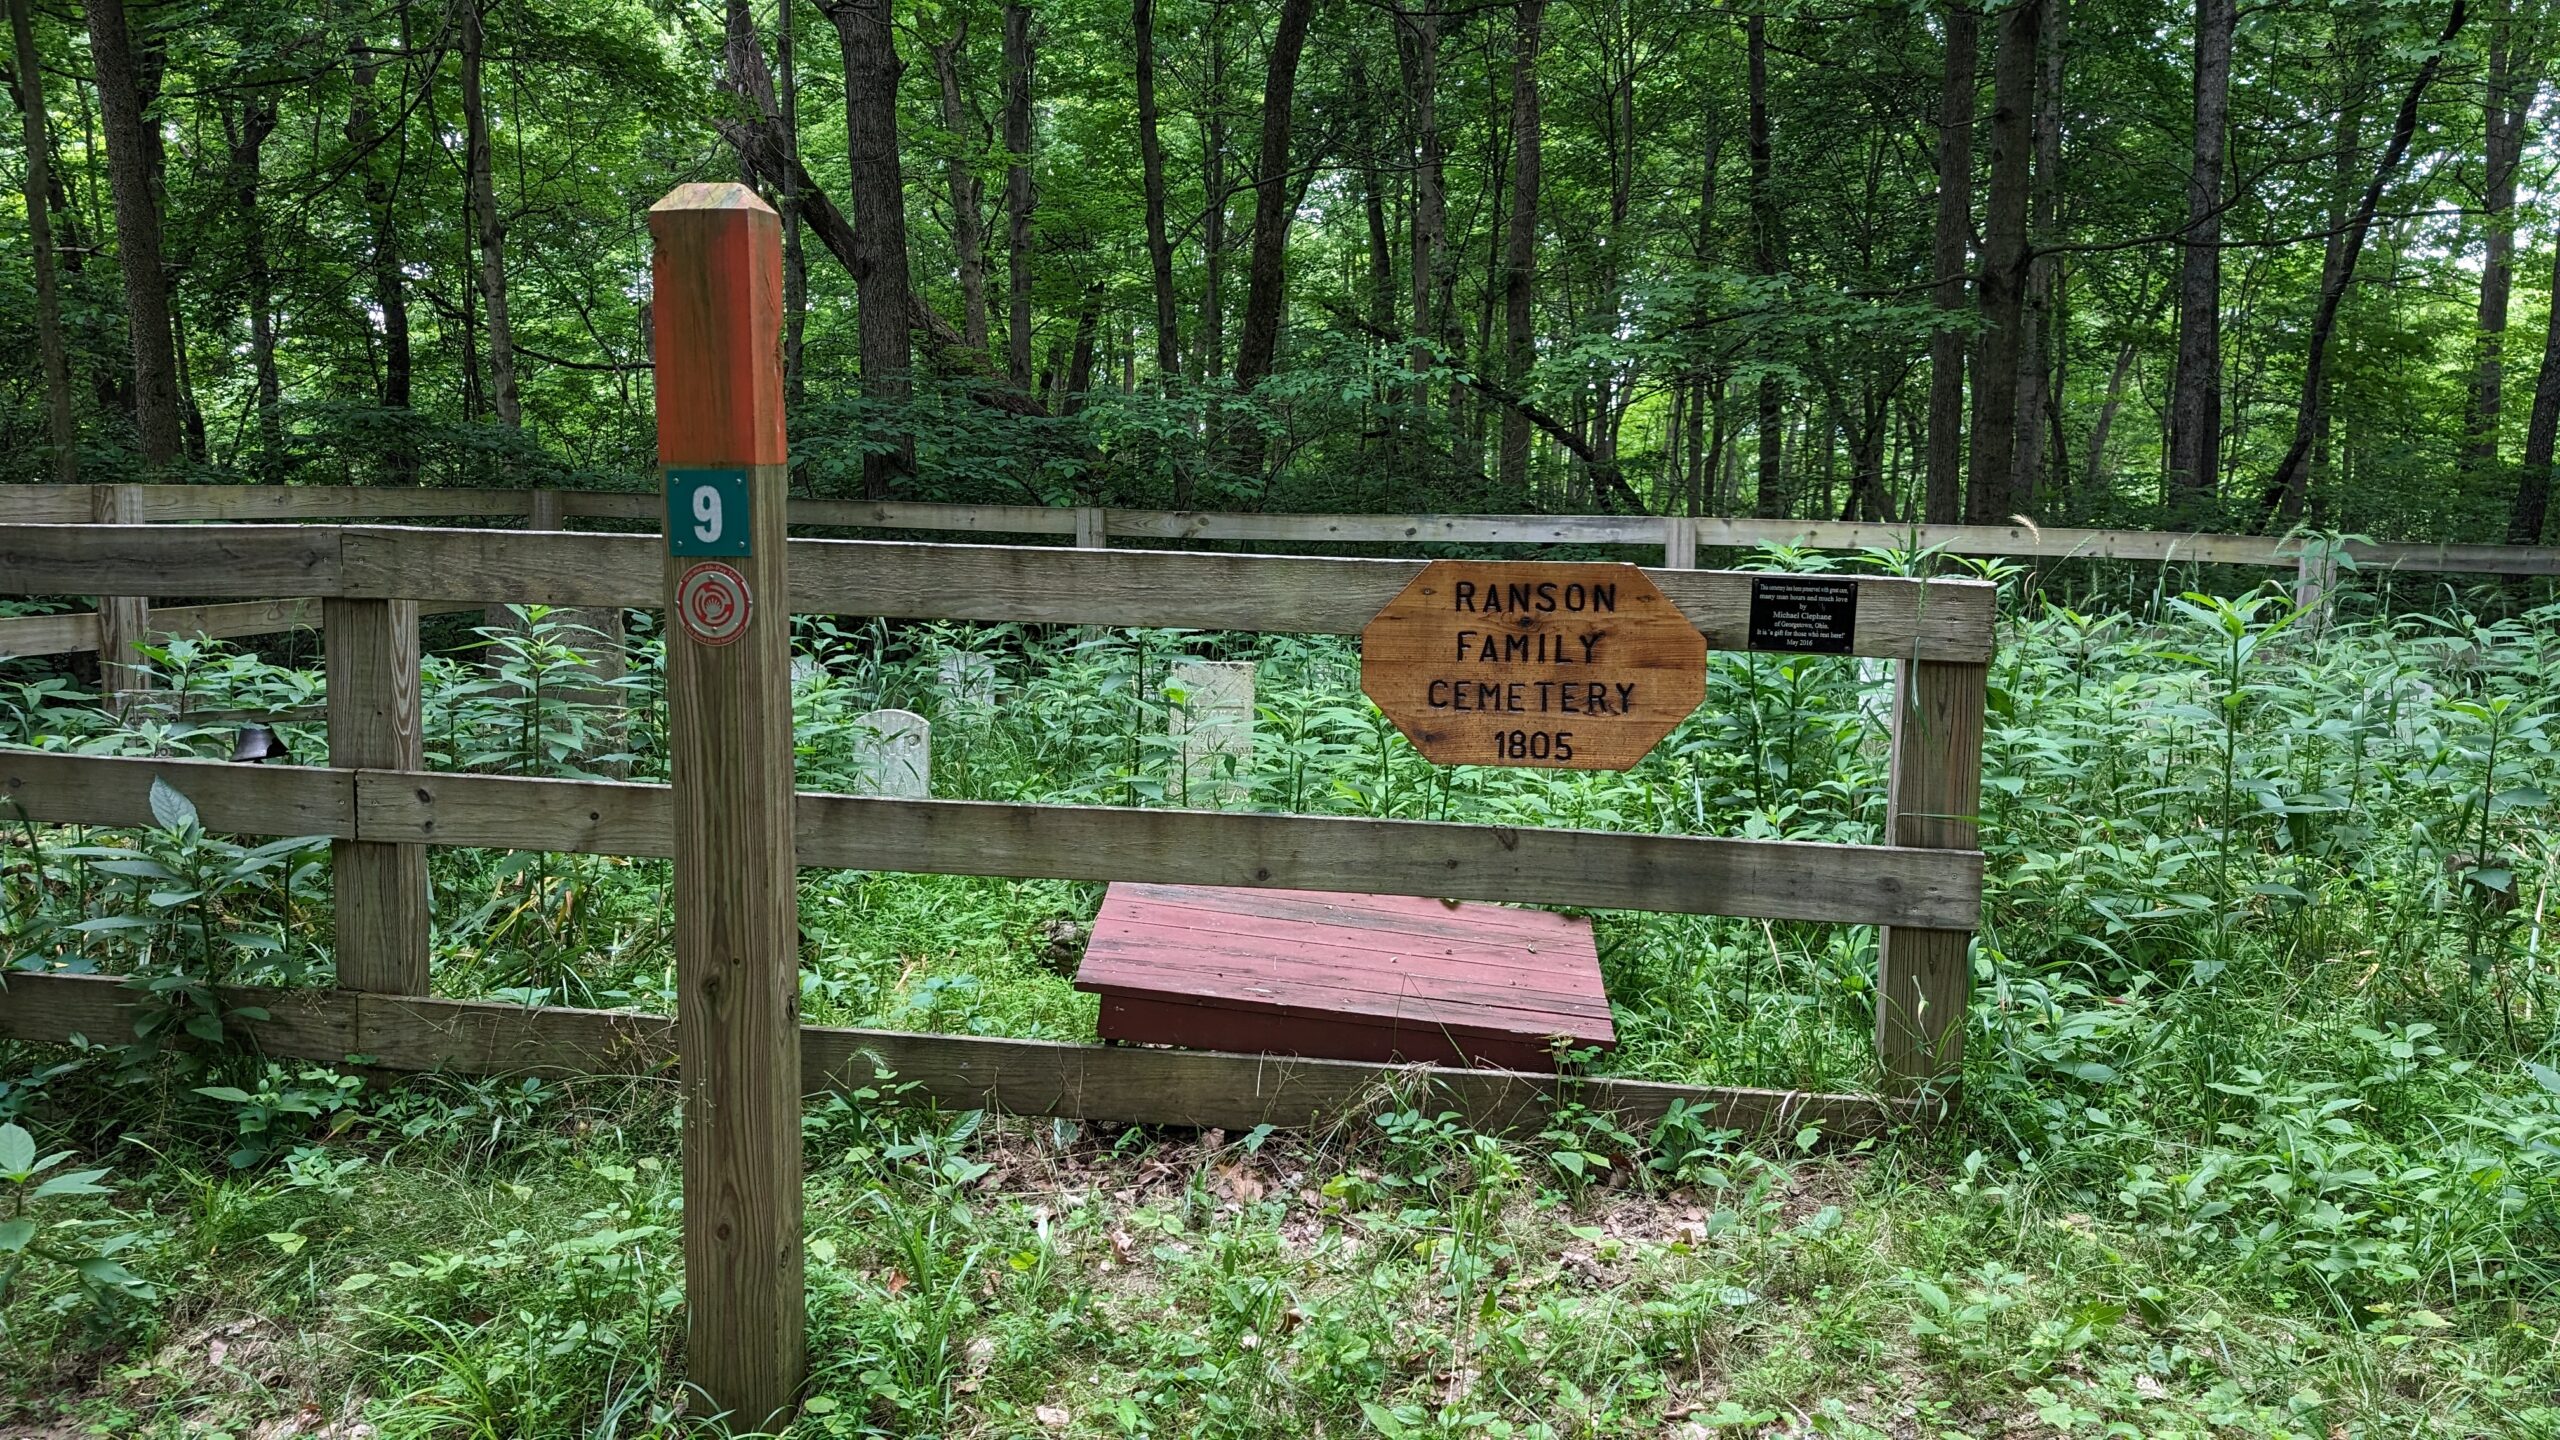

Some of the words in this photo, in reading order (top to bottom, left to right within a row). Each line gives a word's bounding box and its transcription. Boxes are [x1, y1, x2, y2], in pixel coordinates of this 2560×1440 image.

[692, 485, 723, 543] 9
[1455, 581, 1617, 613] RANSON
[1799, 602, 1808, 611] by
[1772, 611, 1800, 619] Michael
[1801, 612, 1832, 621] Clephane
[1780, 621, 1814, 629] Georgetown,
[1774, 629, 1784, 637] gift
[1786, 639, 1798, 647] May
[1457, 631, 1603, 664] FAMILY
[1427, 679, 1635, 714] CEMETERY
[1494, 729, 1574, 761] 1805
